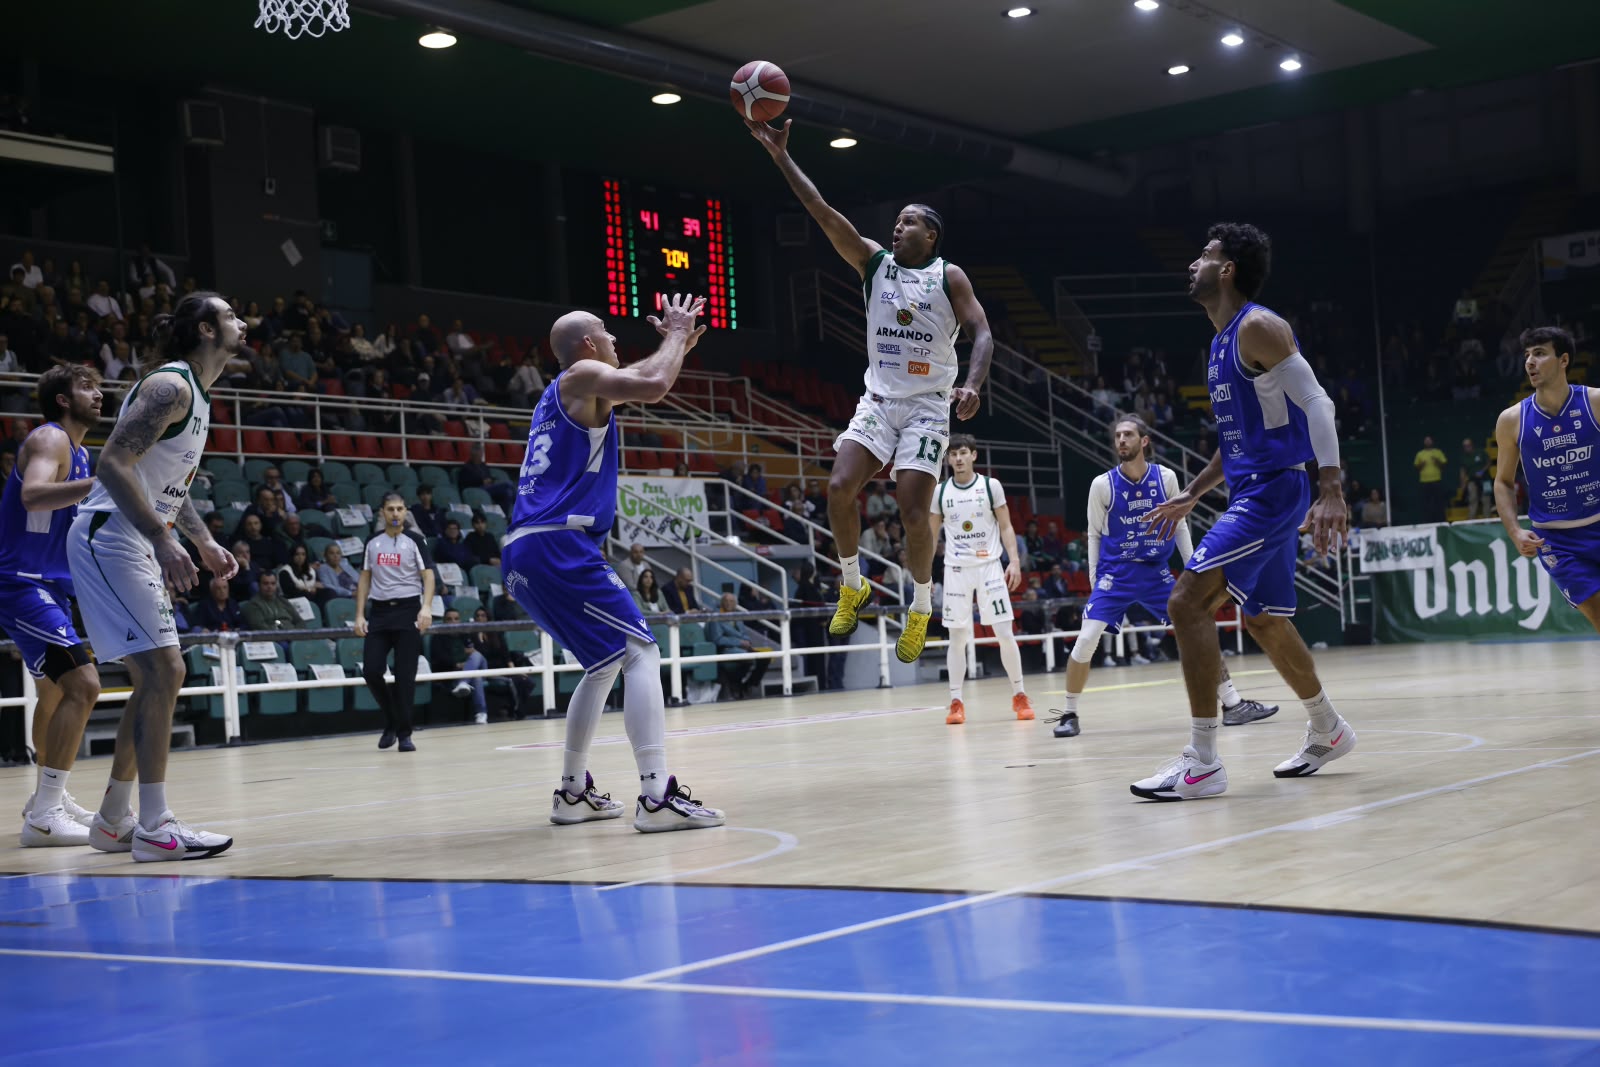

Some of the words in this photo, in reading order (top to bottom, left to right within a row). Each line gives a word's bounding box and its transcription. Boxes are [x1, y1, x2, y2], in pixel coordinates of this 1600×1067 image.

[640, 210, 659, 231] 41
[682, 217, 701, 238] 39
[884, 264, 898, 281] 13
[918, 302, 932, 311] SIA
[876, 327, 933, 342] ARMANDO
[1219, 349, 1225, 360] 4
[191, 416, 202, 436] 73
[1573, 420, 1582, 430] 9
[916, 436, 942, 464] 13
[1532, 445, 1592, 469] VeroDol
[1559, 470, 1590, 483] DATALITE
[946, 499, 954, 508] 11
[954, 531, 986, 540] ARMANDO
[1192, 546, 1208, 562] 4
[991, 598, 1007, 615] 11
